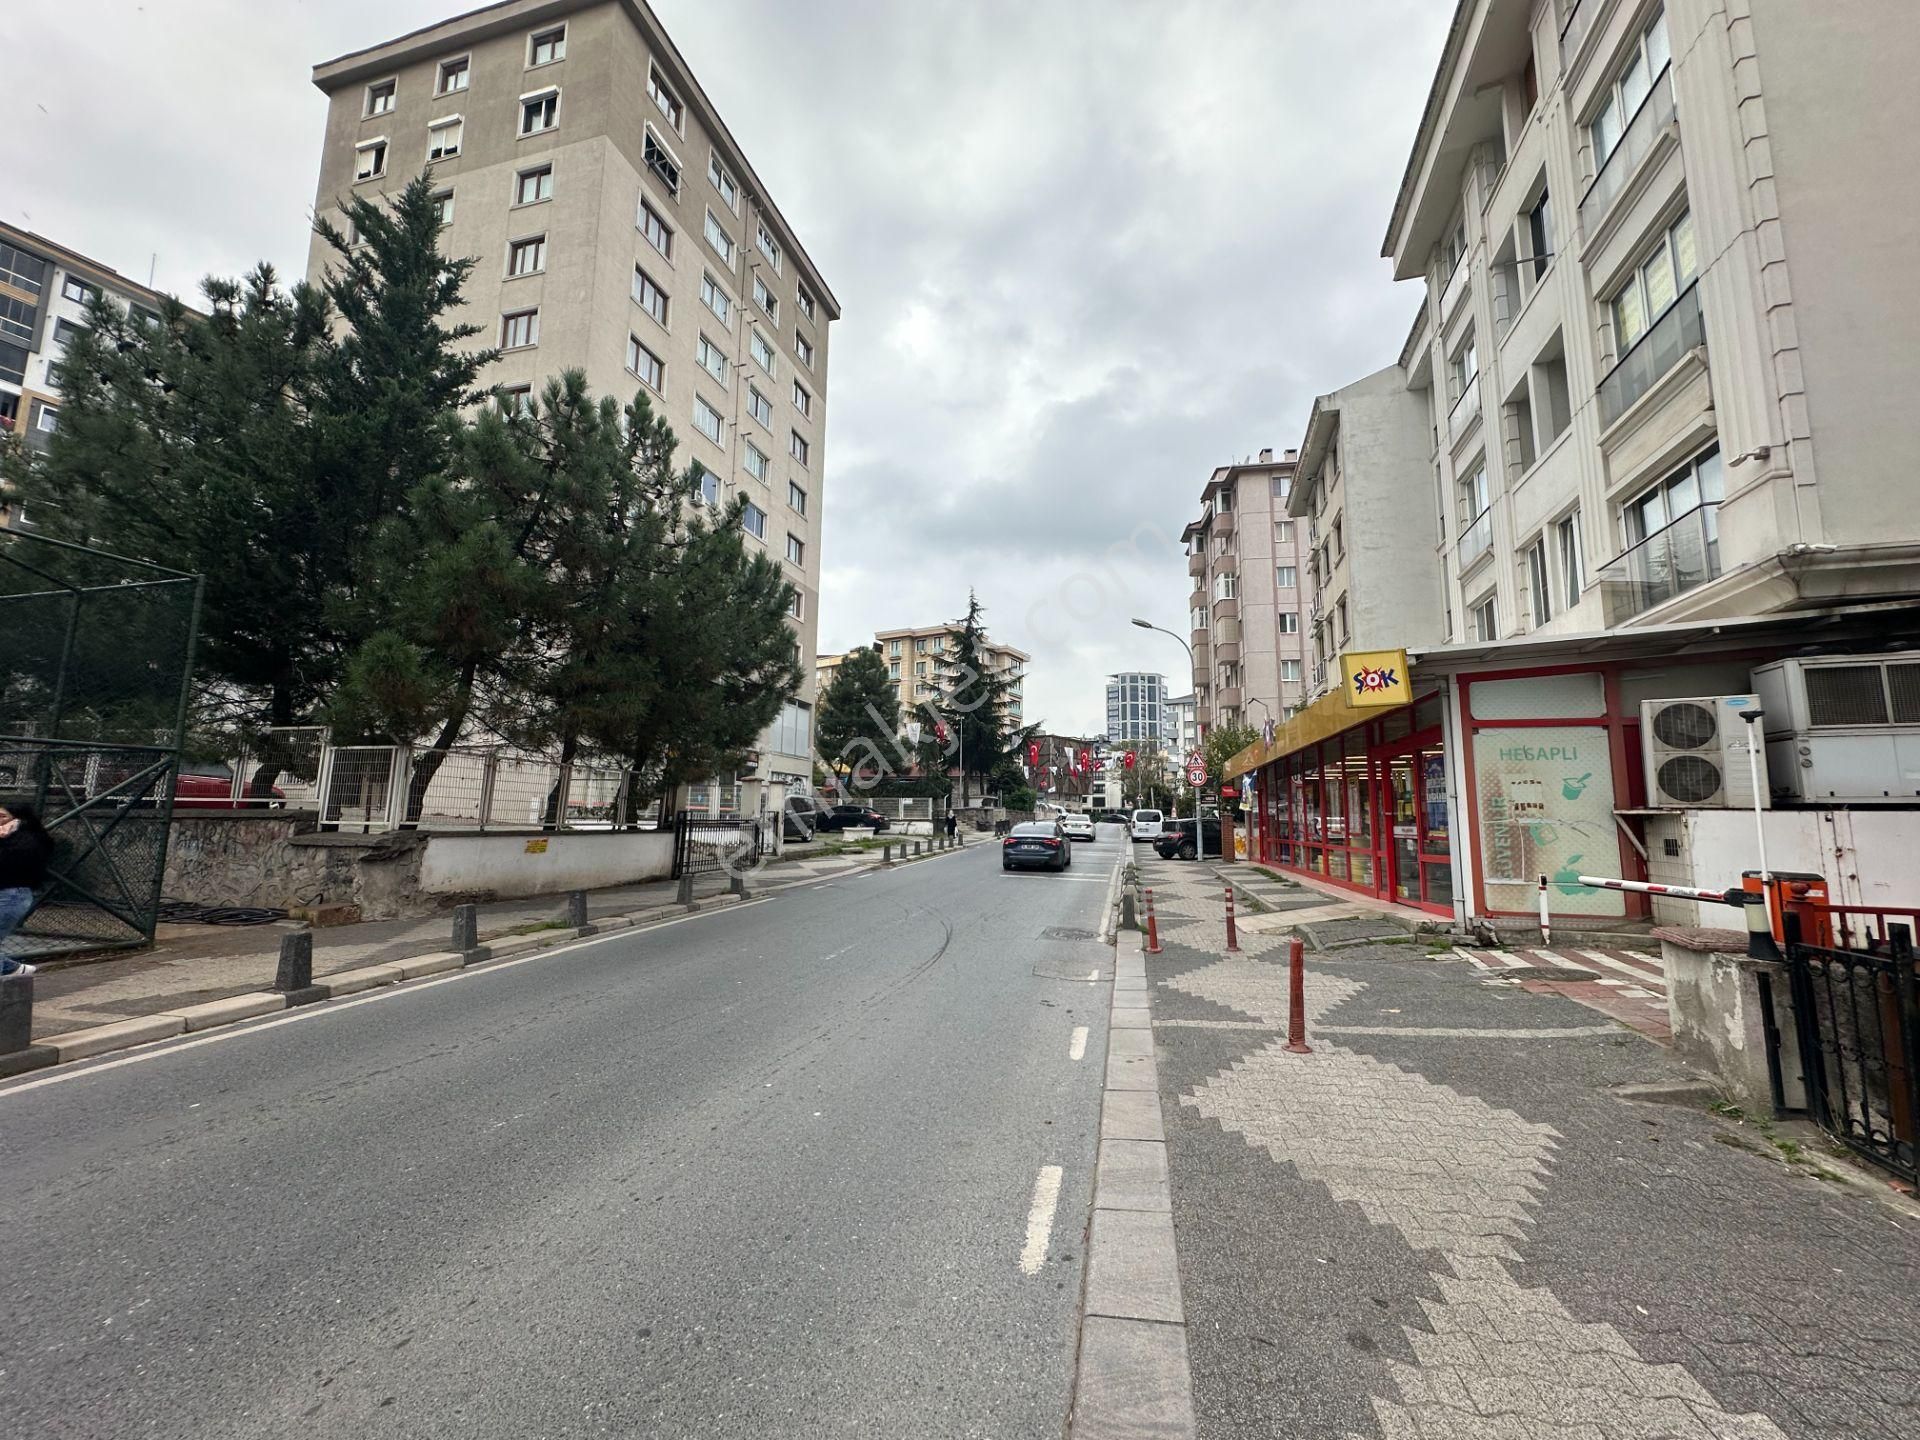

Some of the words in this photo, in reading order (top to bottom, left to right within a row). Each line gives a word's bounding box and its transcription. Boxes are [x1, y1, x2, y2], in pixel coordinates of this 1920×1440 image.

[1353, 668, 1399, 695] ŞOK
[1500, 746, 1578, 761] HESAPLI
[1192, 772, 1203, 782] 30
